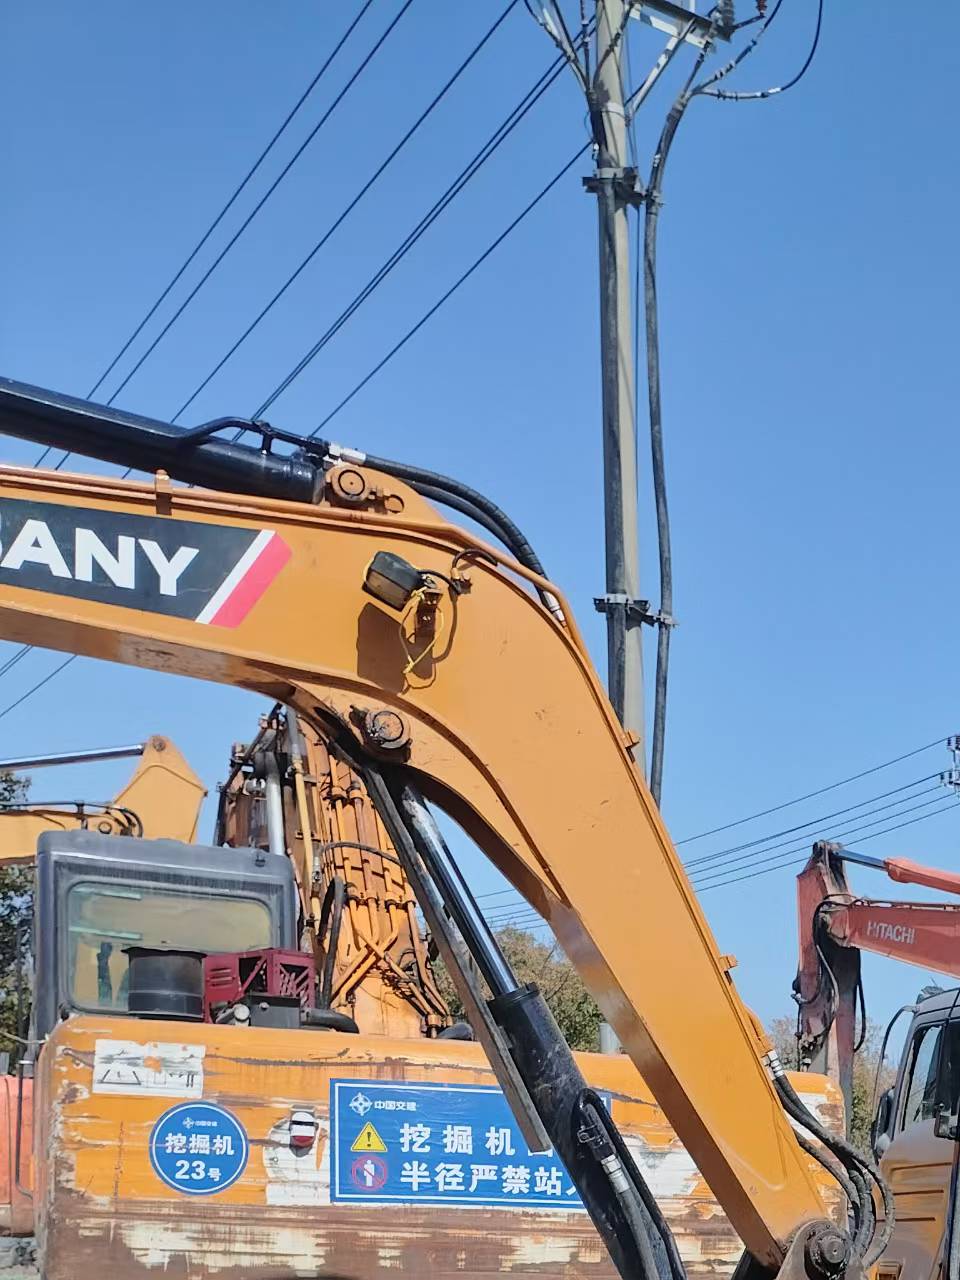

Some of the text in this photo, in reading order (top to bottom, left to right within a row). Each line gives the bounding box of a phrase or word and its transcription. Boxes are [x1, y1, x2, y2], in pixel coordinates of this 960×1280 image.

[0, 518, 200, 597] ANY
[866, 920, 916, 945] HITACHI
[374, 1100, 417, 1112] 中国交建
[164, 1132, 235, 1156] 挖掘机
[400, 1123, 553, 1157] 挖掘机
[174, 1159, 222, 1182] 23号
